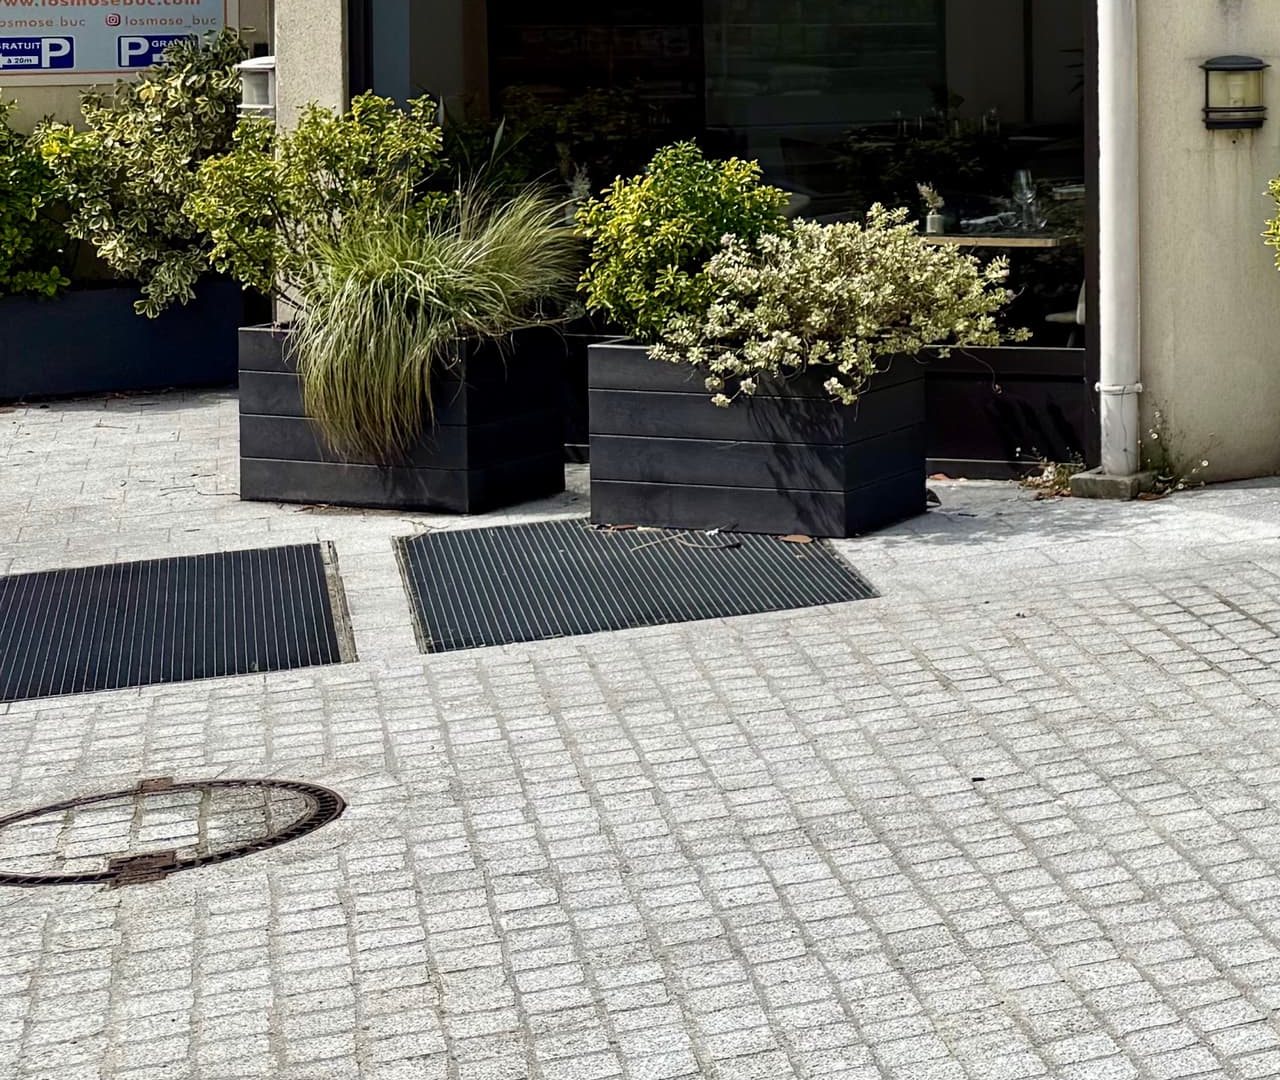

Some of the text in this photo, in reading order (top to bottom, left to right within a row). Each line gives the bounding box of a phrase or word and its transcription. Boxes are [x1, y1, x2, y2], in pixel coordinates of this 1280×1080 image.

[0, 42, 40, 50] RATUIT
[41, 38, 71, 68] P
[120, 37, 149, 66] P
